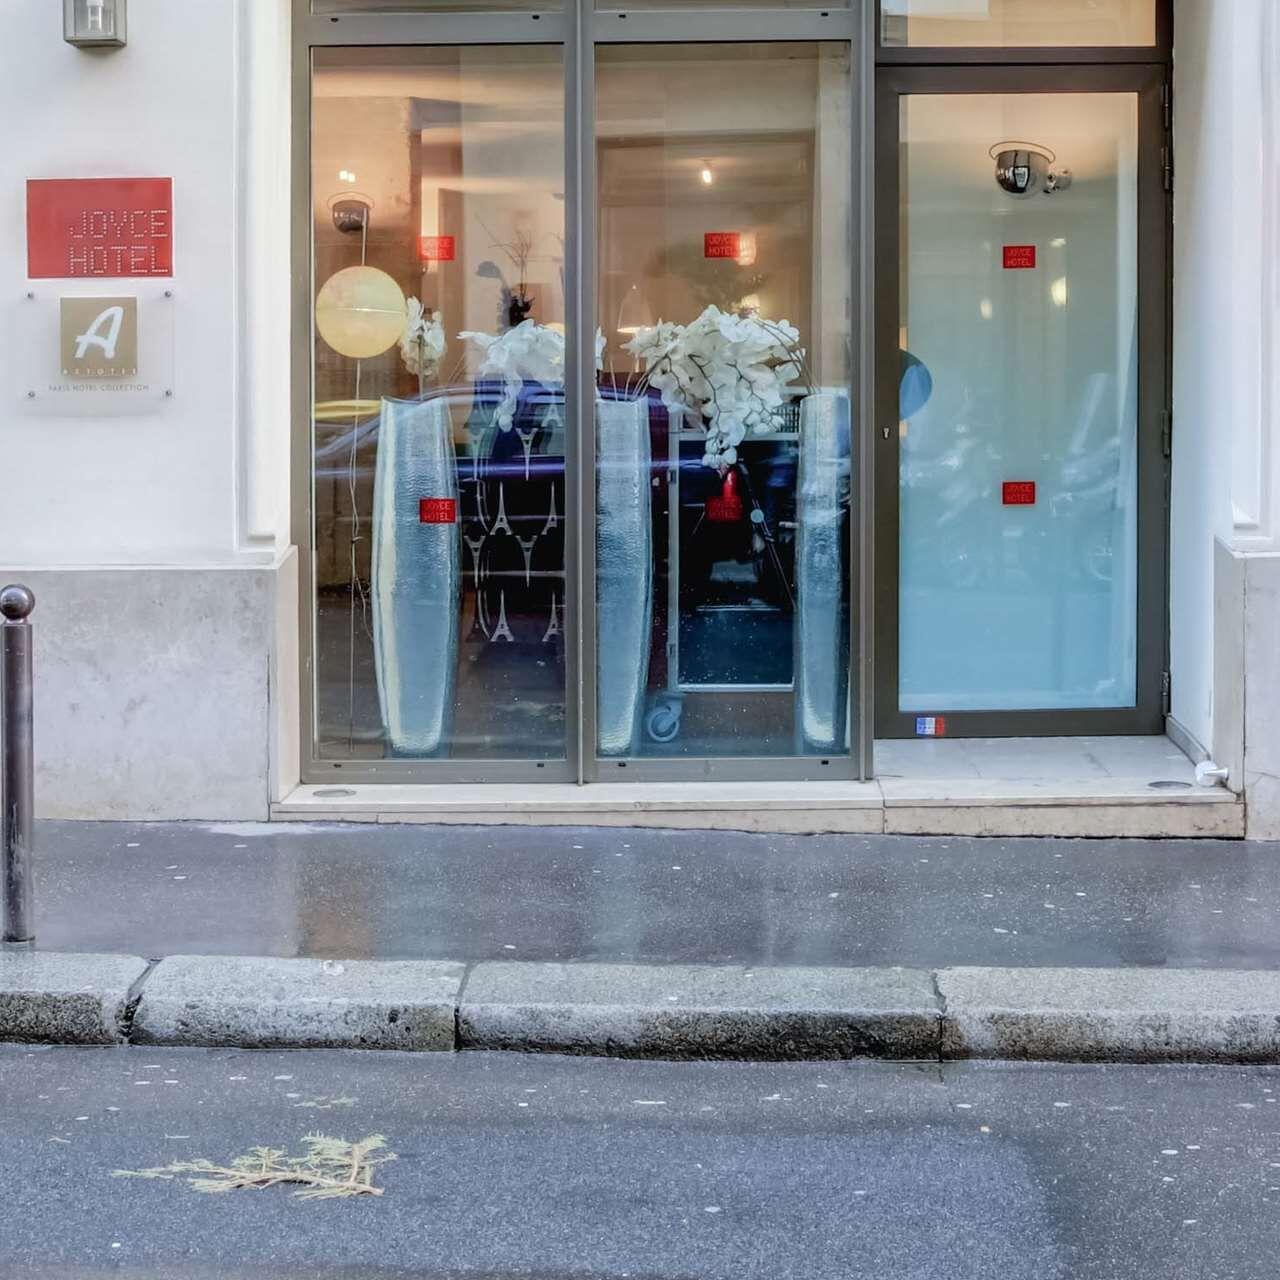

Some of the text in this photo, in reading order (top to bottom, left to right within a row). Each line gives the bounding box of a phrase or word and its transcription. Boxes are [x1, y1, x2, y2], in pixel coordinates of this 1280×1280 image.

[69, 209, 168, 239] JOYCE
[709, 234, 738, 245] JOYC
[69, 245, 169, 273] HOTEL
[1007, 258, 1031, 267] HOTEL
[74, 305, 125, 360] A
[423, 511, 451, 521] HOTEL
